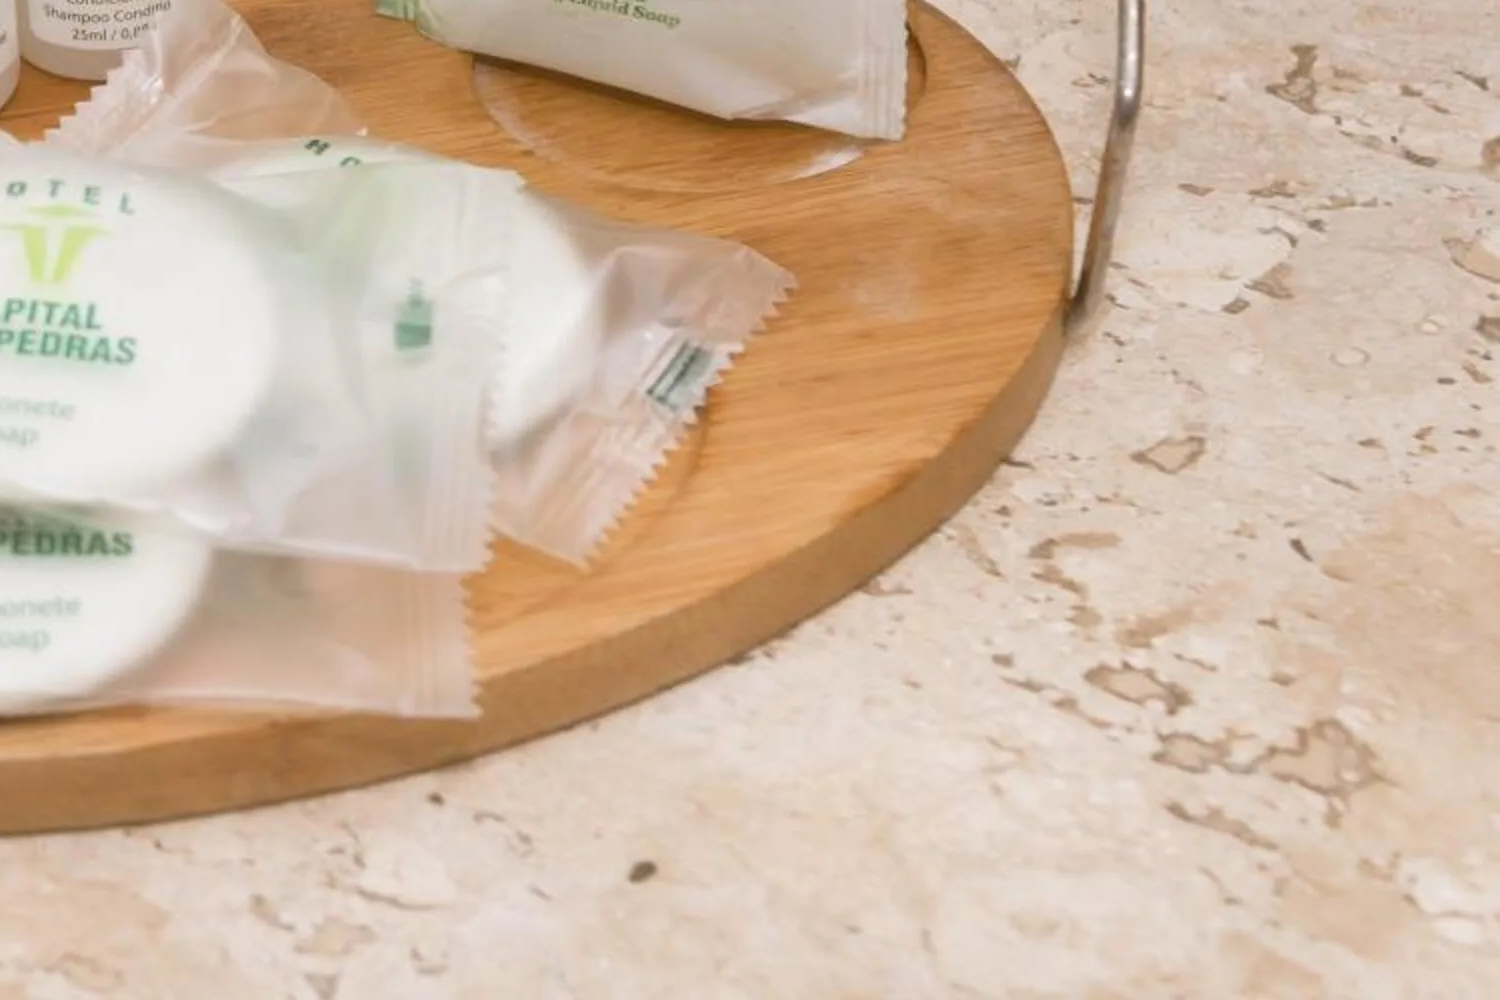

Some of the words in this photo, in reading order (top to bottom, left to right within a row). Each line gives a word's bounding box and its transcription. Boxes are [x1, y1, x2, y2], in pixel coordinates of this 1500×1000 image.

[44, 3, 110, 25] Shampoo
[632, 5, 682, 29] Soap
[71, 27, 107, 41] 25ml
